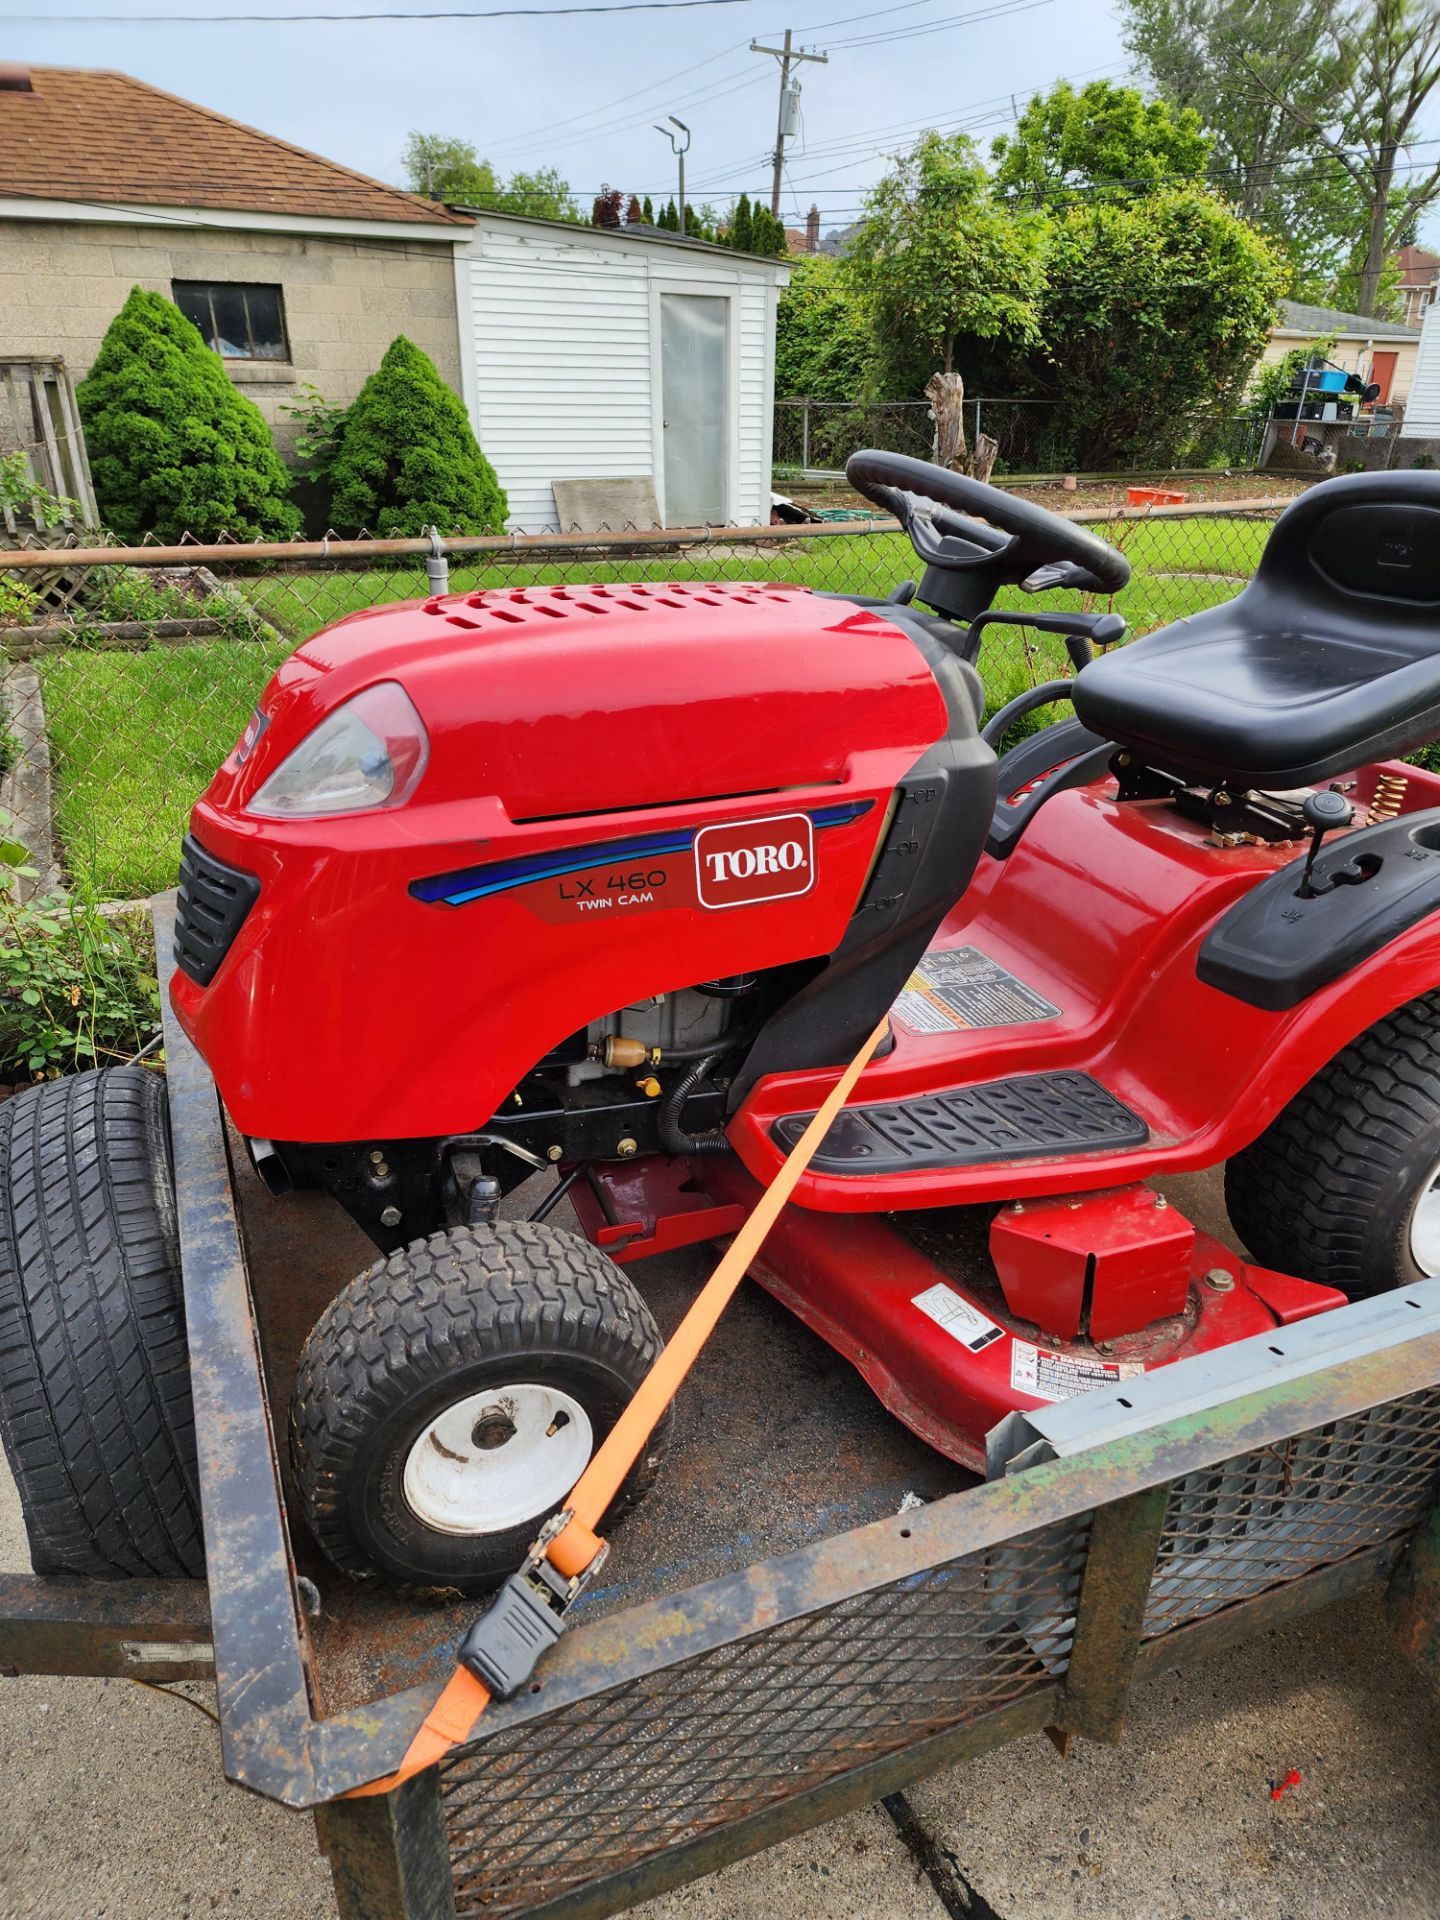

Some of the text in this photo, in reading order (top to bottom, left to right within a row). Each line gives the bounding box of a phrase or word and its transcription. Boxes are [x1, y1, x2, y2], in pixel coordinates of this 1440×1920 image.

[559, 870, 667, 900] LX 460
[577, 892, 654, 912] TWIN CAM
[1059, 1356, 1105, 1370] DANGER
